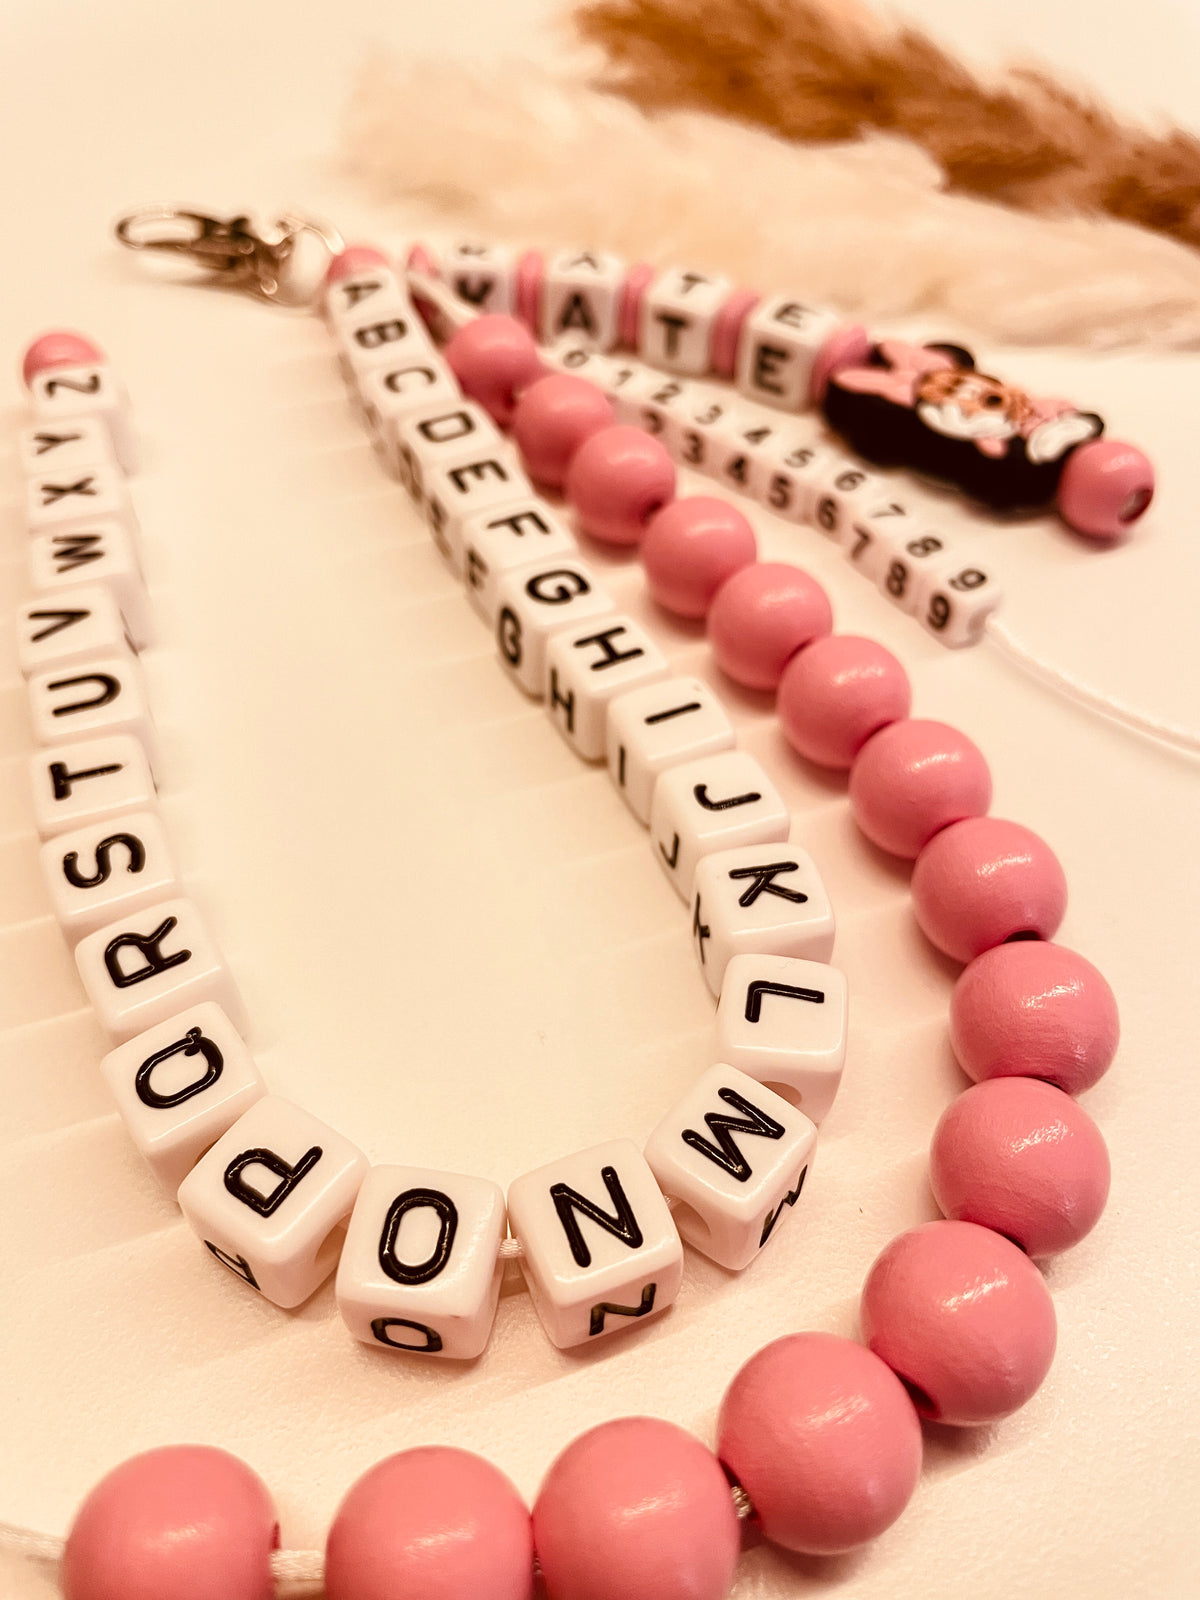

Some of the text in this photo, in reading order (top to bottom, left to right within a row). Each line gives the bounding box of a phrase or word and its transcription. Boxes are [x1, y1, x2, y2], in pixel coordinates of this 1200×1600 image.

[342, 280, 382, 310] A
[354, 317, 409, 349] B
[655, 310, 693, 360] T
[753, 342, 790, 397] E
[384, 365, 438, 394] C
[33, 432, 83, 456] Y
[417, 410, 476, 444] D
[41, 475, 98, 506] X
[447, 458, 510, 495] E
[651, 383, 683, 404] 2
[694, 404, 723, 425] 3
[742, 426, 773, 445] 4
[784, 449, 815, 469] 5
[834, 470, 867, 491] 6
[872, 503, 906, 518] 7
[906, 536, 943, 558] 8
[948, 568, 987, 592] 9
[486, 510, 551, 537] F
[682, 429, 704, 465] 3
[726, 452, 749, 486] 4
[768, 472, 792, 510] 5
[817, 495, 838, 531] 6
[851, 523, 873, 561] 7
[885, 559, 908, 598] 8
[927, 592, 951, 632] 9
[51, 534, 105, 574] W
[525, 569, 592, 606] G
[28, 609, 91, 643] V
[573, 626, 645, 671] H
[47, 672, 122, 718] U
[48, 760, 125, 801] T
[693, 783, 762, 812] J
[63, 832, 146, 889] S
[728, 861, 808, 908] K
[104, 916, 192, 989] R
[744, 980, 826, 1023] L
[135, 1026, 225, 1109] Q
[223, 1145, 324, 1219] P
[378, 1187, 459, 1286] O
[549, 1165, 644, 1268] N
